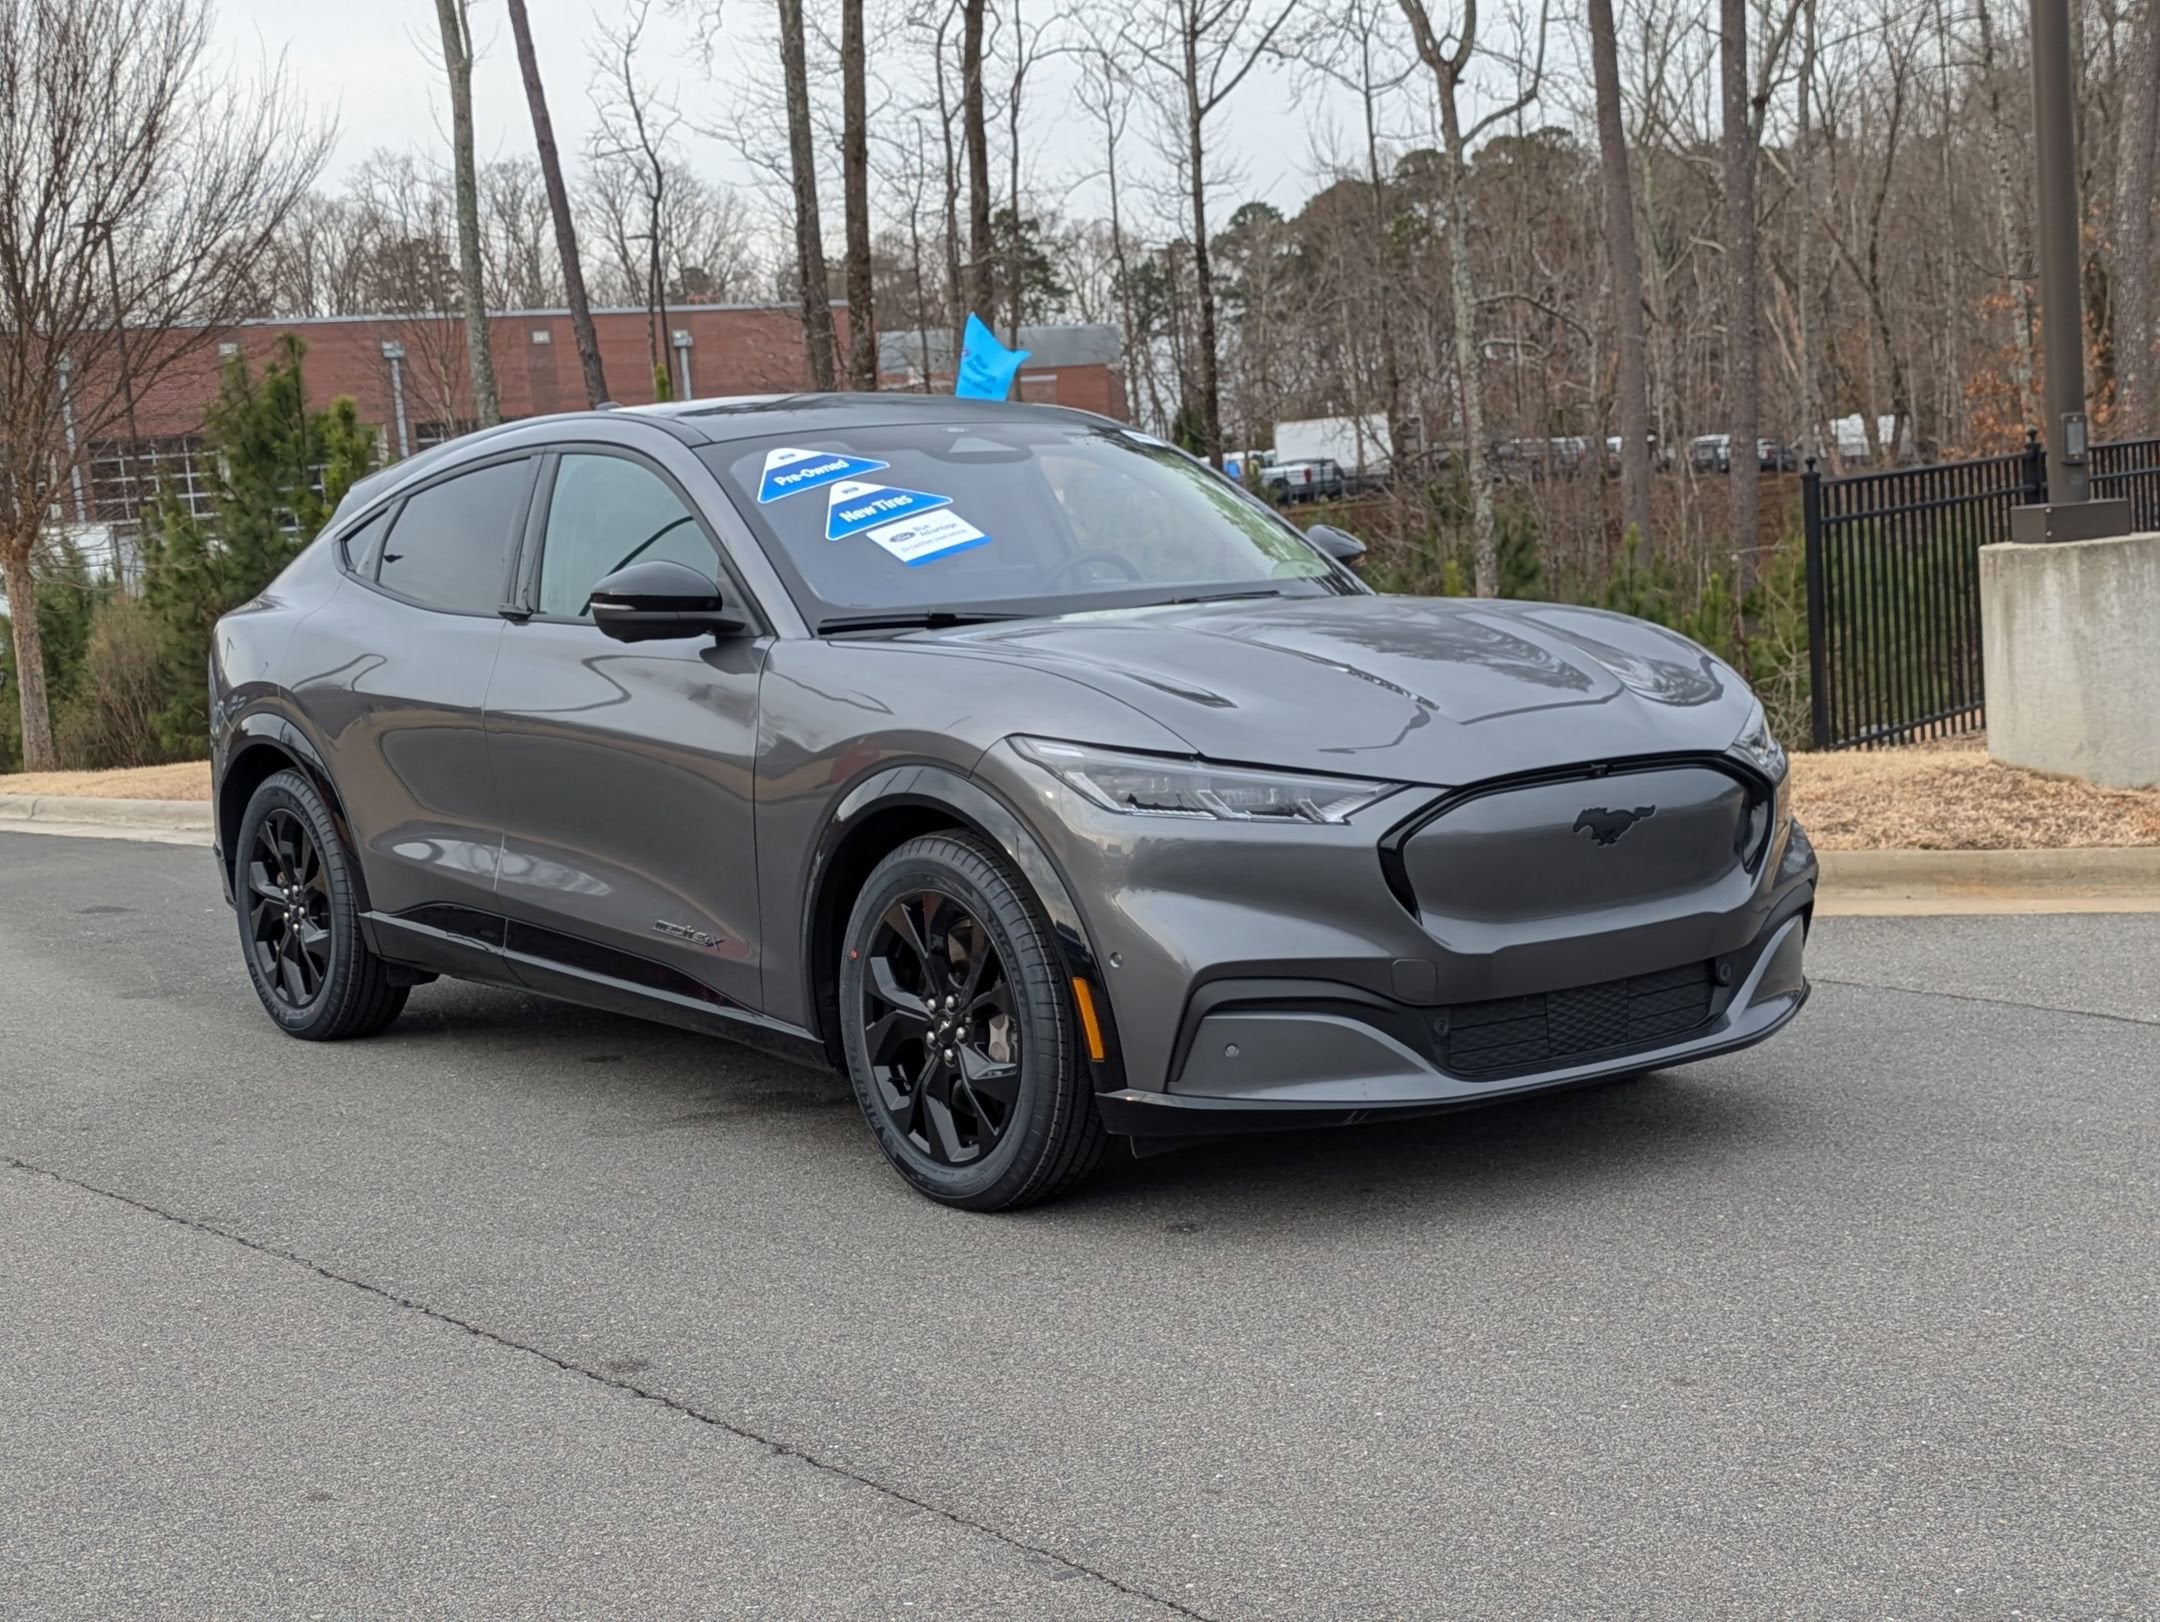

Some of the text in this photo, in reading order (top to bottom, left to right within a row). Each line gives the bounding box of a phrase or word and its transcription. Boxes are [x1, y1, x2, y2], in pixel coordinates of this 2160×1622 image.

[773, 460, 850, 486] Pre-Owned
[839, 495, 914, 523] New Tires
